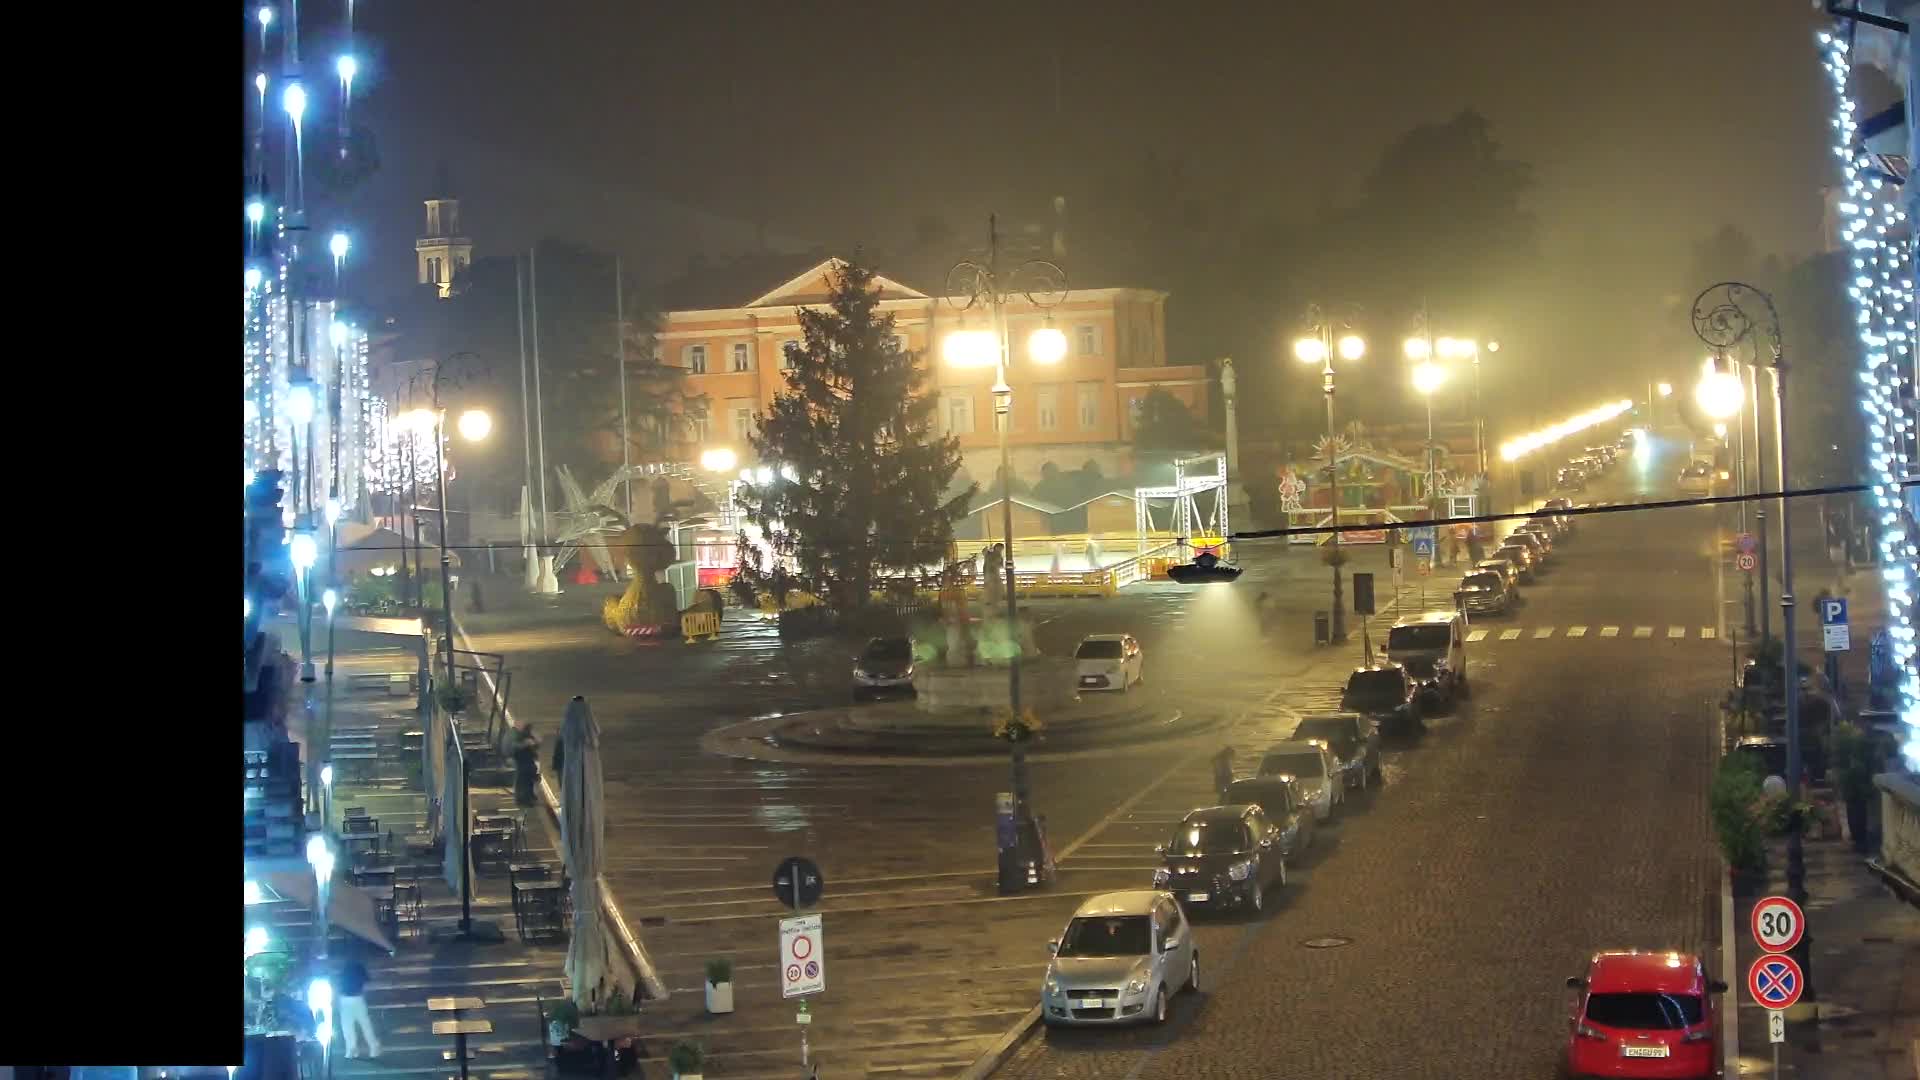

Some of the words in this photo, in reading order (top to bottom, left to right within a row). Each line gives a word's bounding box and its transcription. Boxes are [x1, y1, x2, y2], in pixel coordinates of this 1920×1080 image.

[1742, 557, 1753, 567] 20
[1827, 602, 1842, 621] P
[1762, 912, 1791, 937] 30
[789, 969, 799, 978] 20
